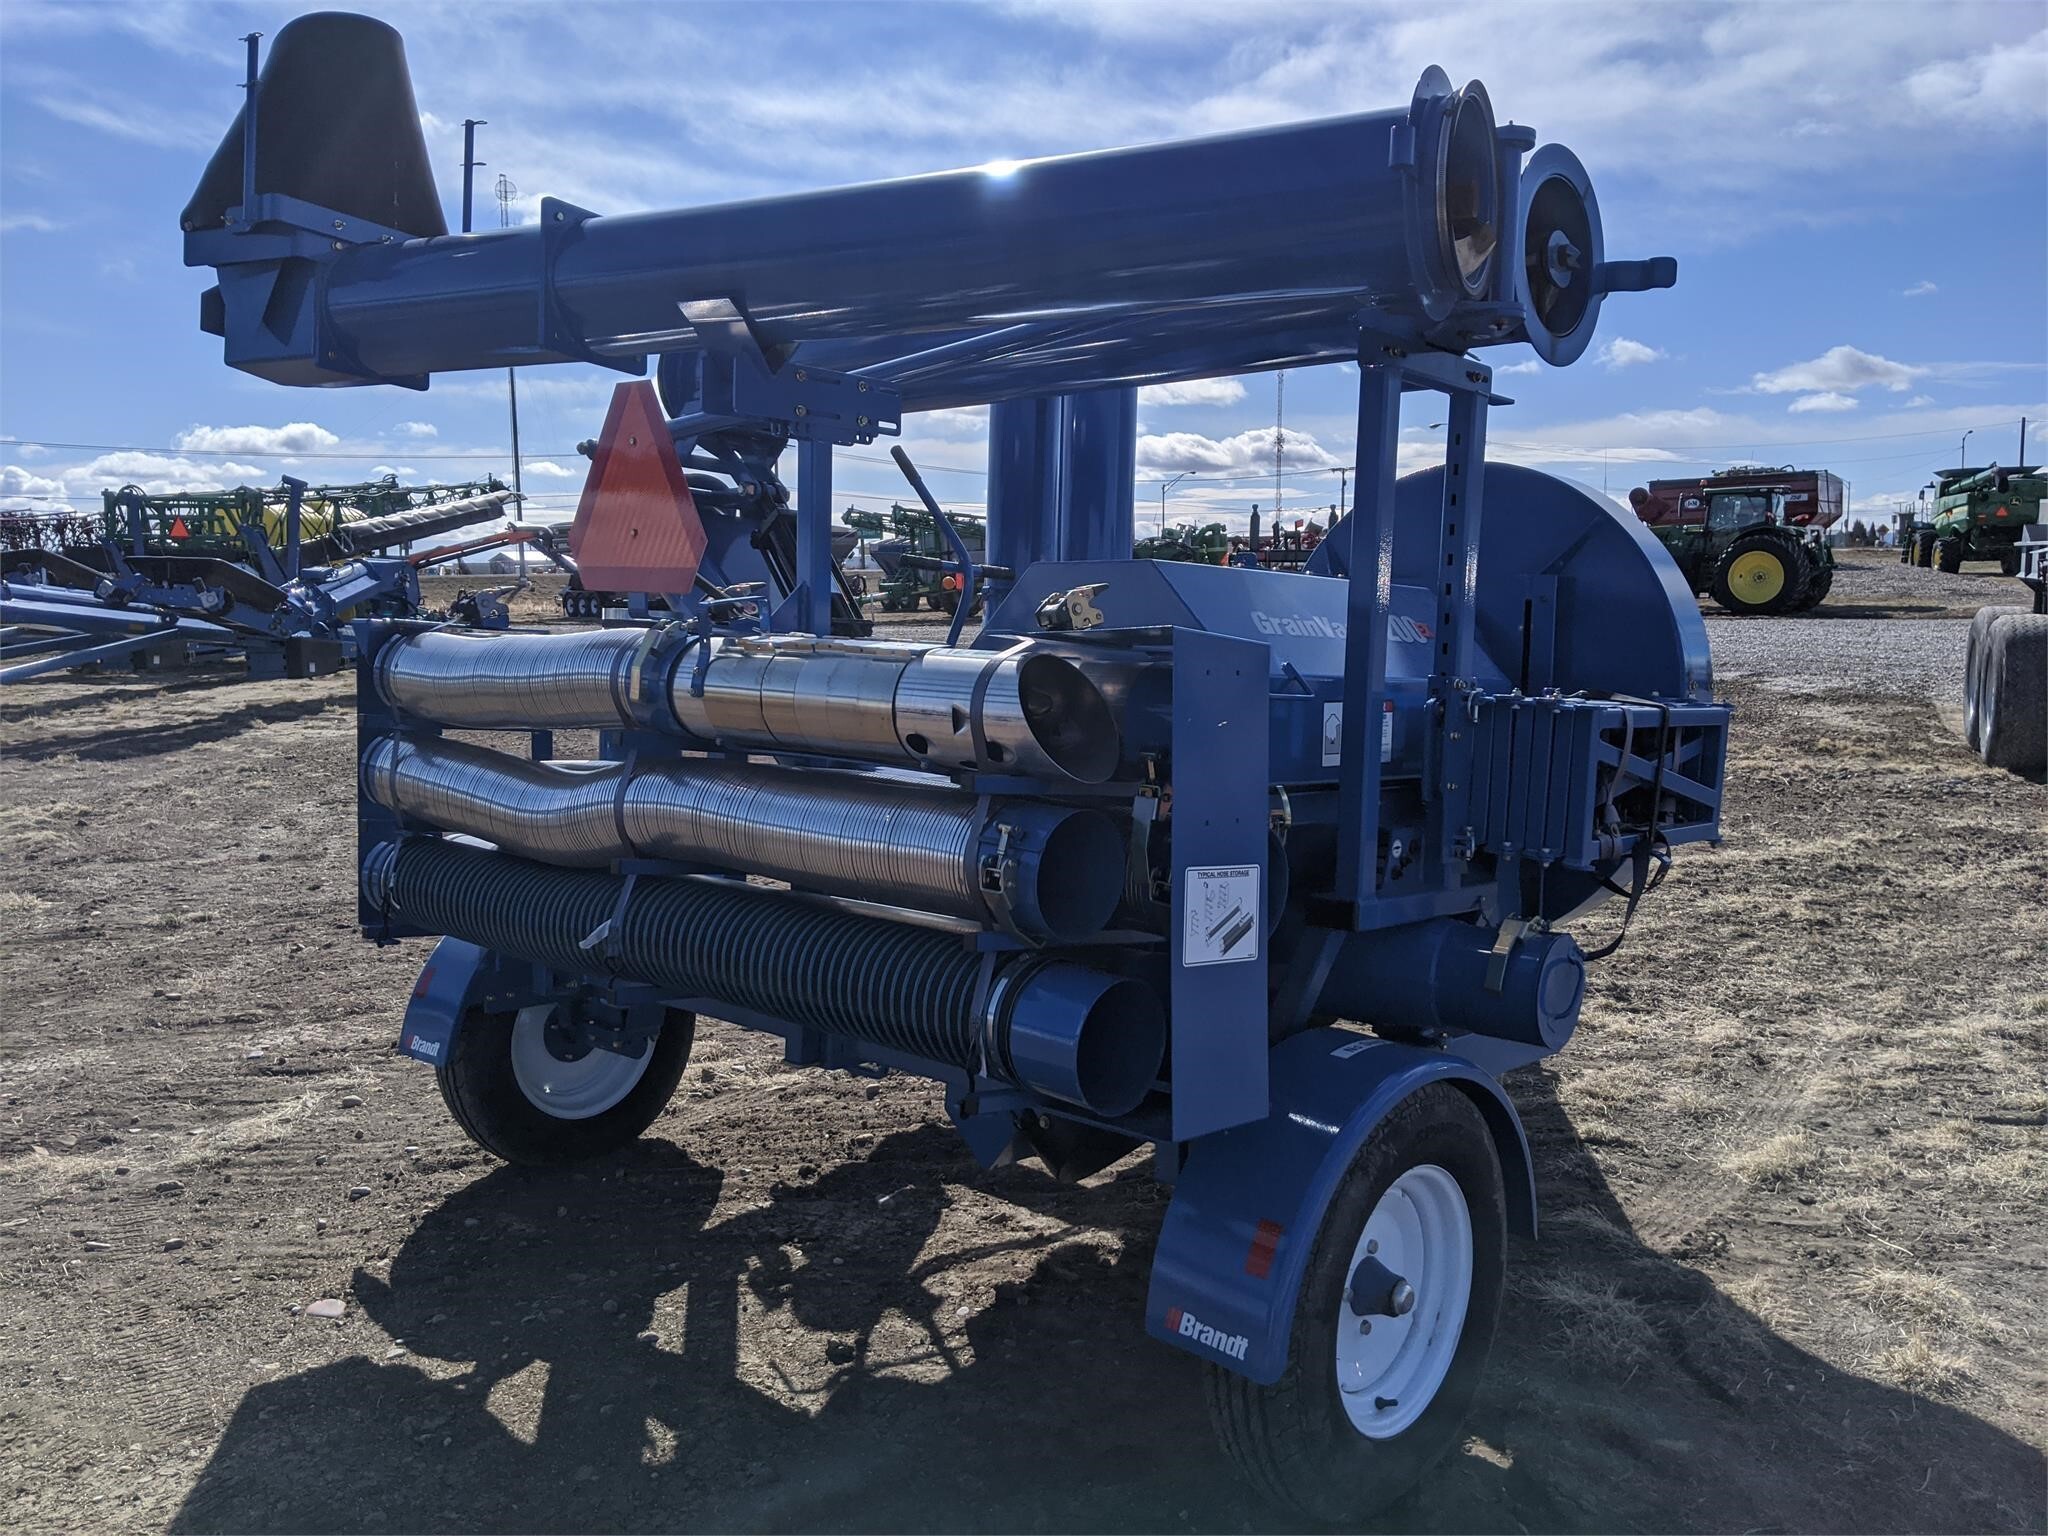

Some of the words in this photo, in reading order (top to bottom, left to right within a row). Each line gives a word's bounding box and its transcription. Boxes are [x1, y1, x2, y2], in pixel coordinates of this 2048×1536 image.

[1250, 611, 1347, 640] GrainVa
[1197, 871, 1215, 879] TYPICAL
[1217, 870, 1229, 878] HOSE
[1230, 869, 1250, 878] STORAGE
[410, 1035, 440, 1057] Brandt
[1178, 1311, 1249, 1361] Brandt
